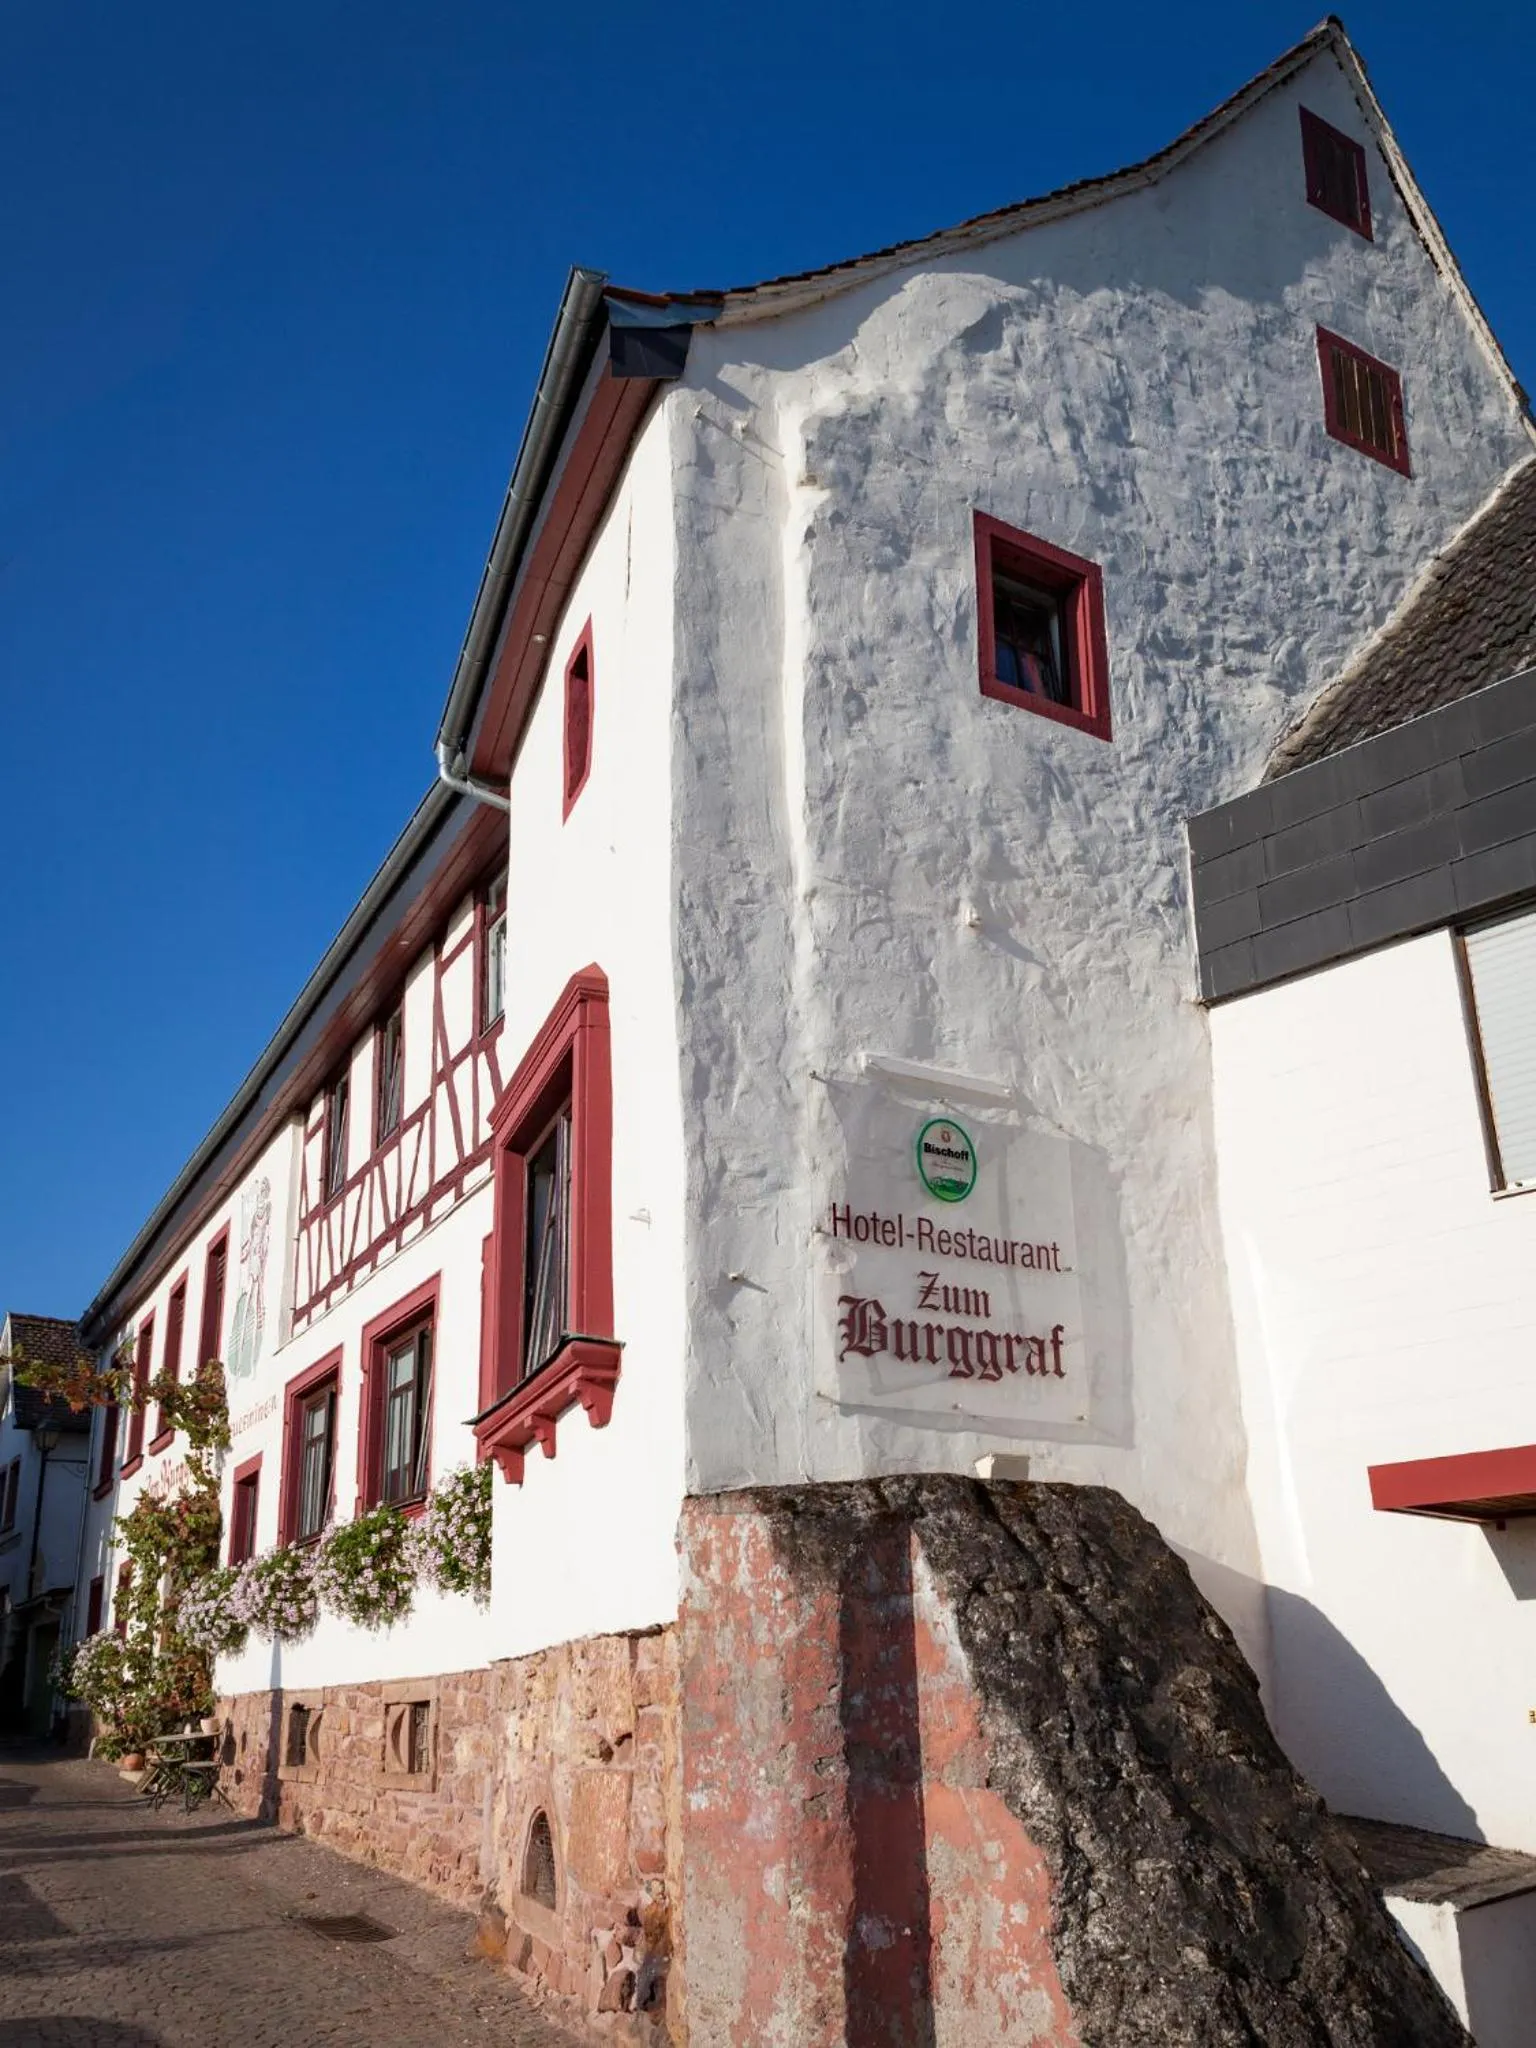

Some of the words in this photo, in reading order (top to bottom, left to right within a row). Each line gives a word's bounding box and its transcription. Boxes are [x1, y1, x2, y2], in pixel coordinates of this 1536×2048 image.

[923, 1142, 969, 1161] Bischoff
[831, 1202, 1063, 1273] Hotel-Restaurant
[916, 1270, 992, 1319] Zum
[837, 1294, 1067, 1382] Burggraf
